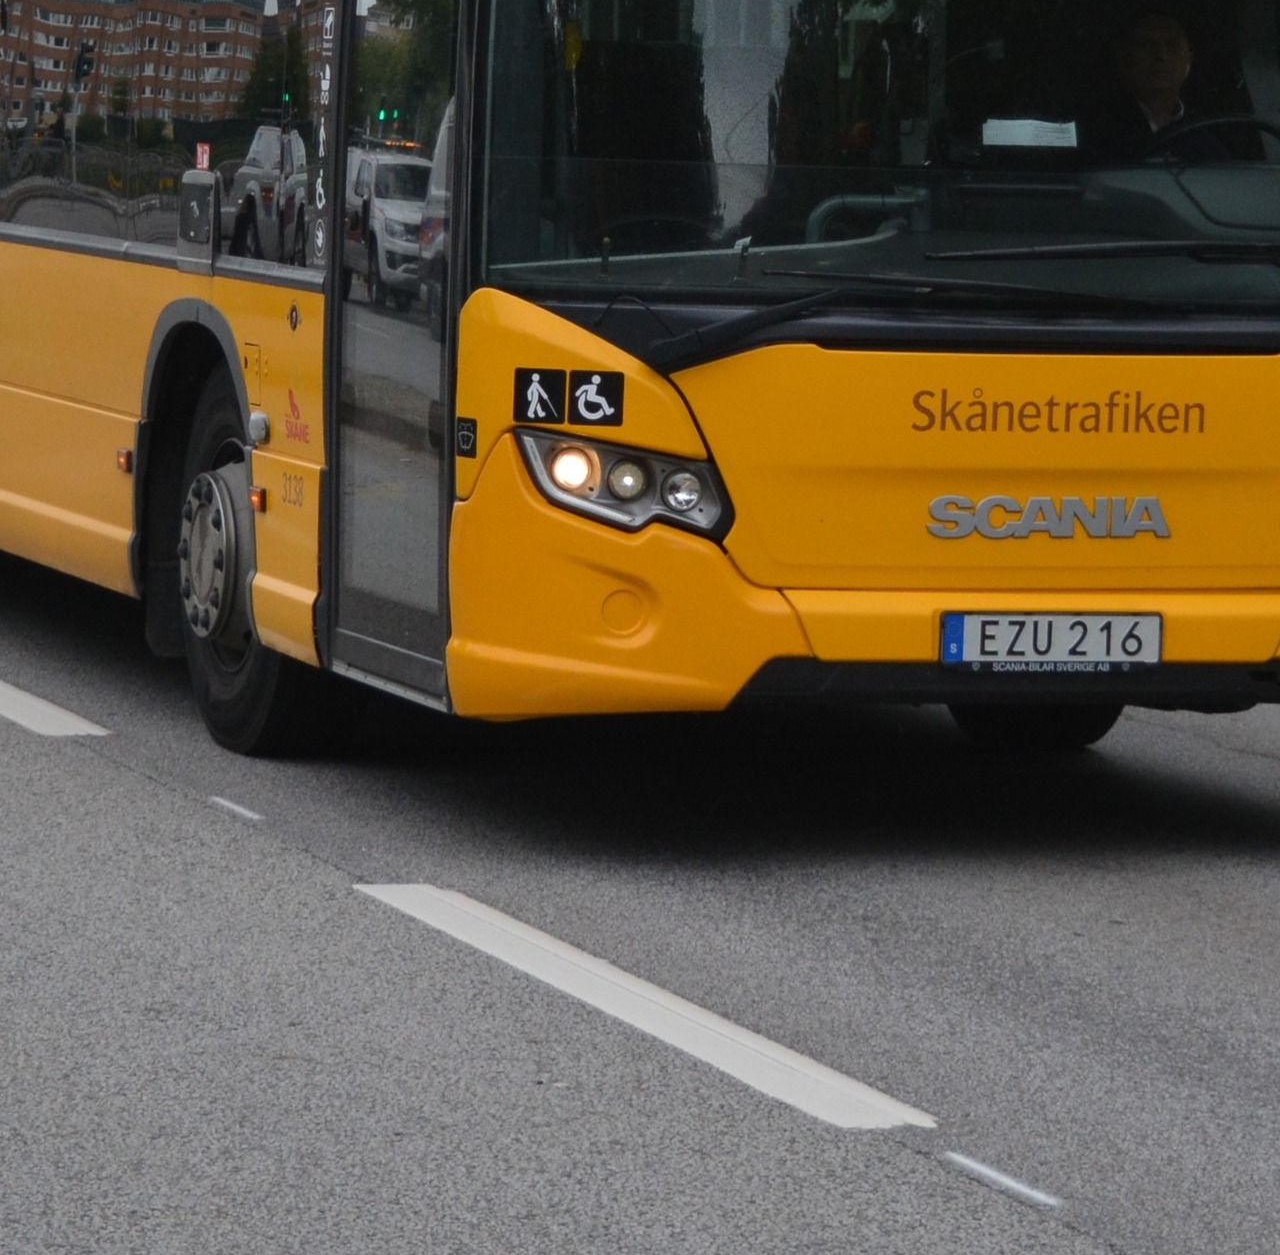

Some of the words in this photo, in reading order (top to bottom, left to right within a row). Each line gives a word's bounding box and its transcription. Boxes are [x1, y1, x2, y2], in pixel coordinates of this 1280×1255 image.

[911, 387, 1206, 434] Skånetrafiken
[282, 472, 304, 507] 3138
[926, 494, 1171, 539] SCANIA
[978, 619, 1054, 657] EZU
[1067, 619, 1144, 658] 216
[1056, 662, 1095, 672] SVERIGE
[1097, 662, 1110, 672] AB
